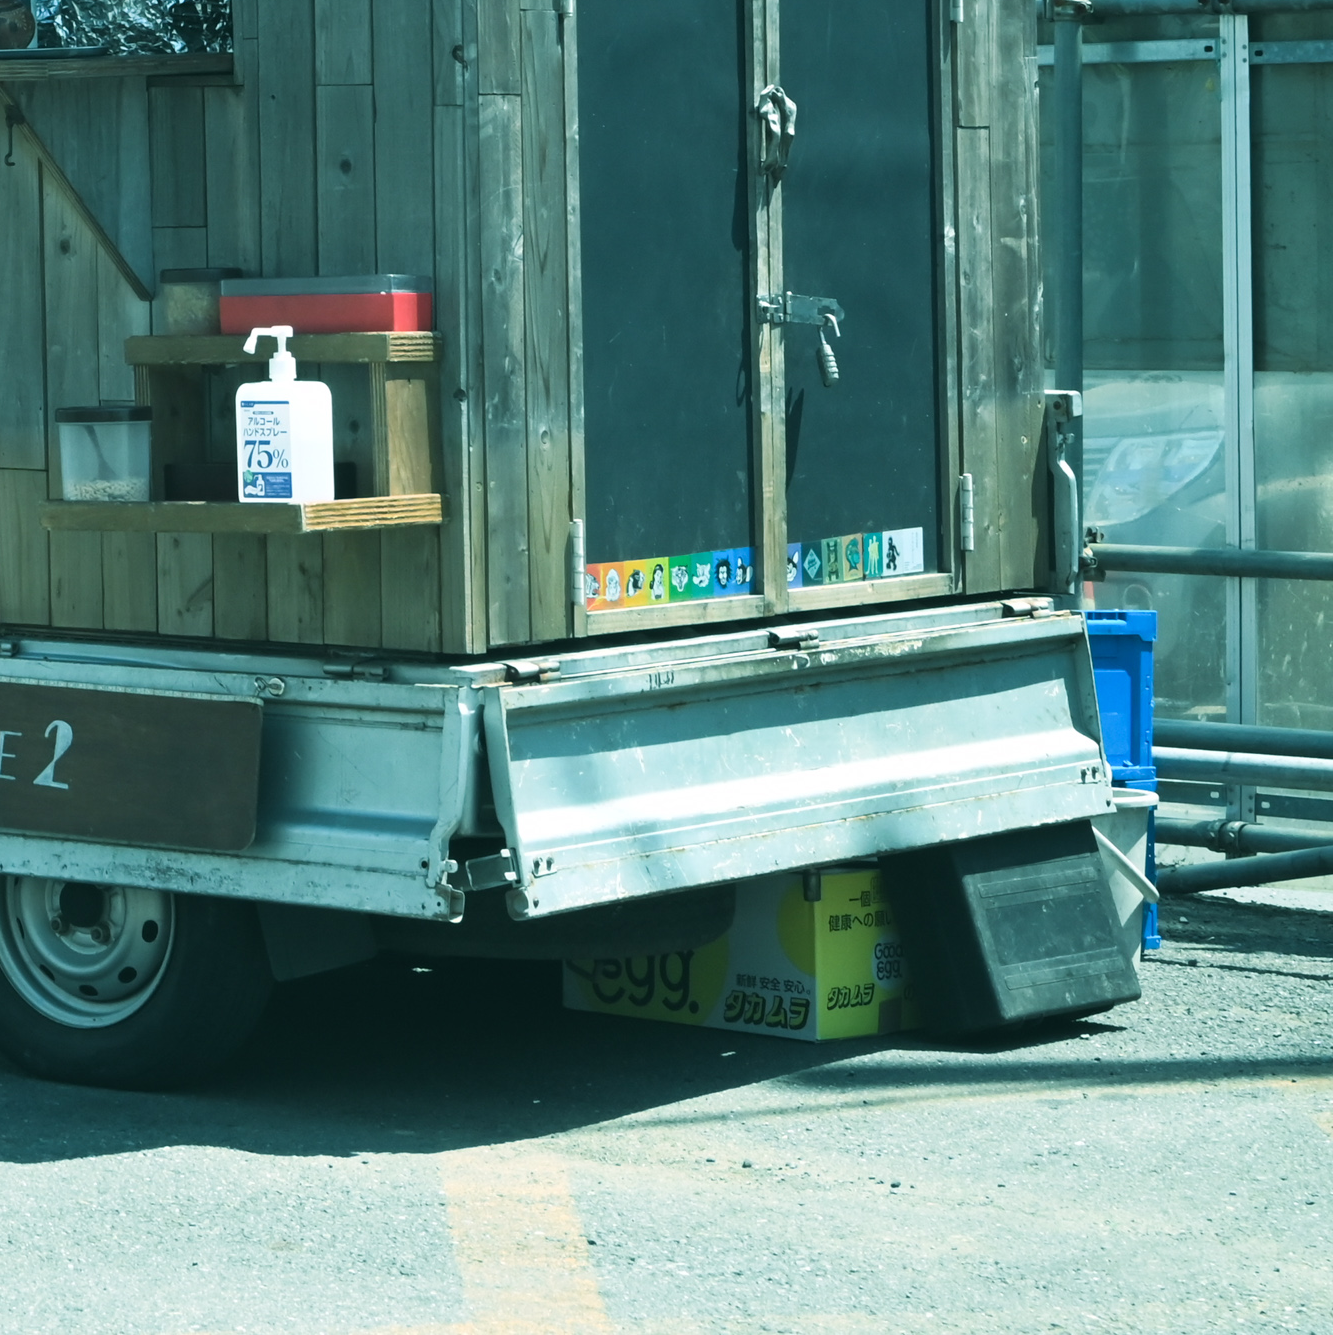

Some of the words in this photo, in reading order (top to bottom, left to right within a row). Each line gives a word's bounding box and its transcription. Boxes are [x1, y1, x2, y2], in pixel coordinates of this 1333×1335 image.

[243, 427, 287, 437] ハンドスプレー
[248, 416, 280, 426] アルコール
[244, 440, 289, 469] 75%
[32, 719, 75, 790] 2
[827, 982, 875, 1010] タカムラ
[723, 990, 811, 1031] タカムラ
